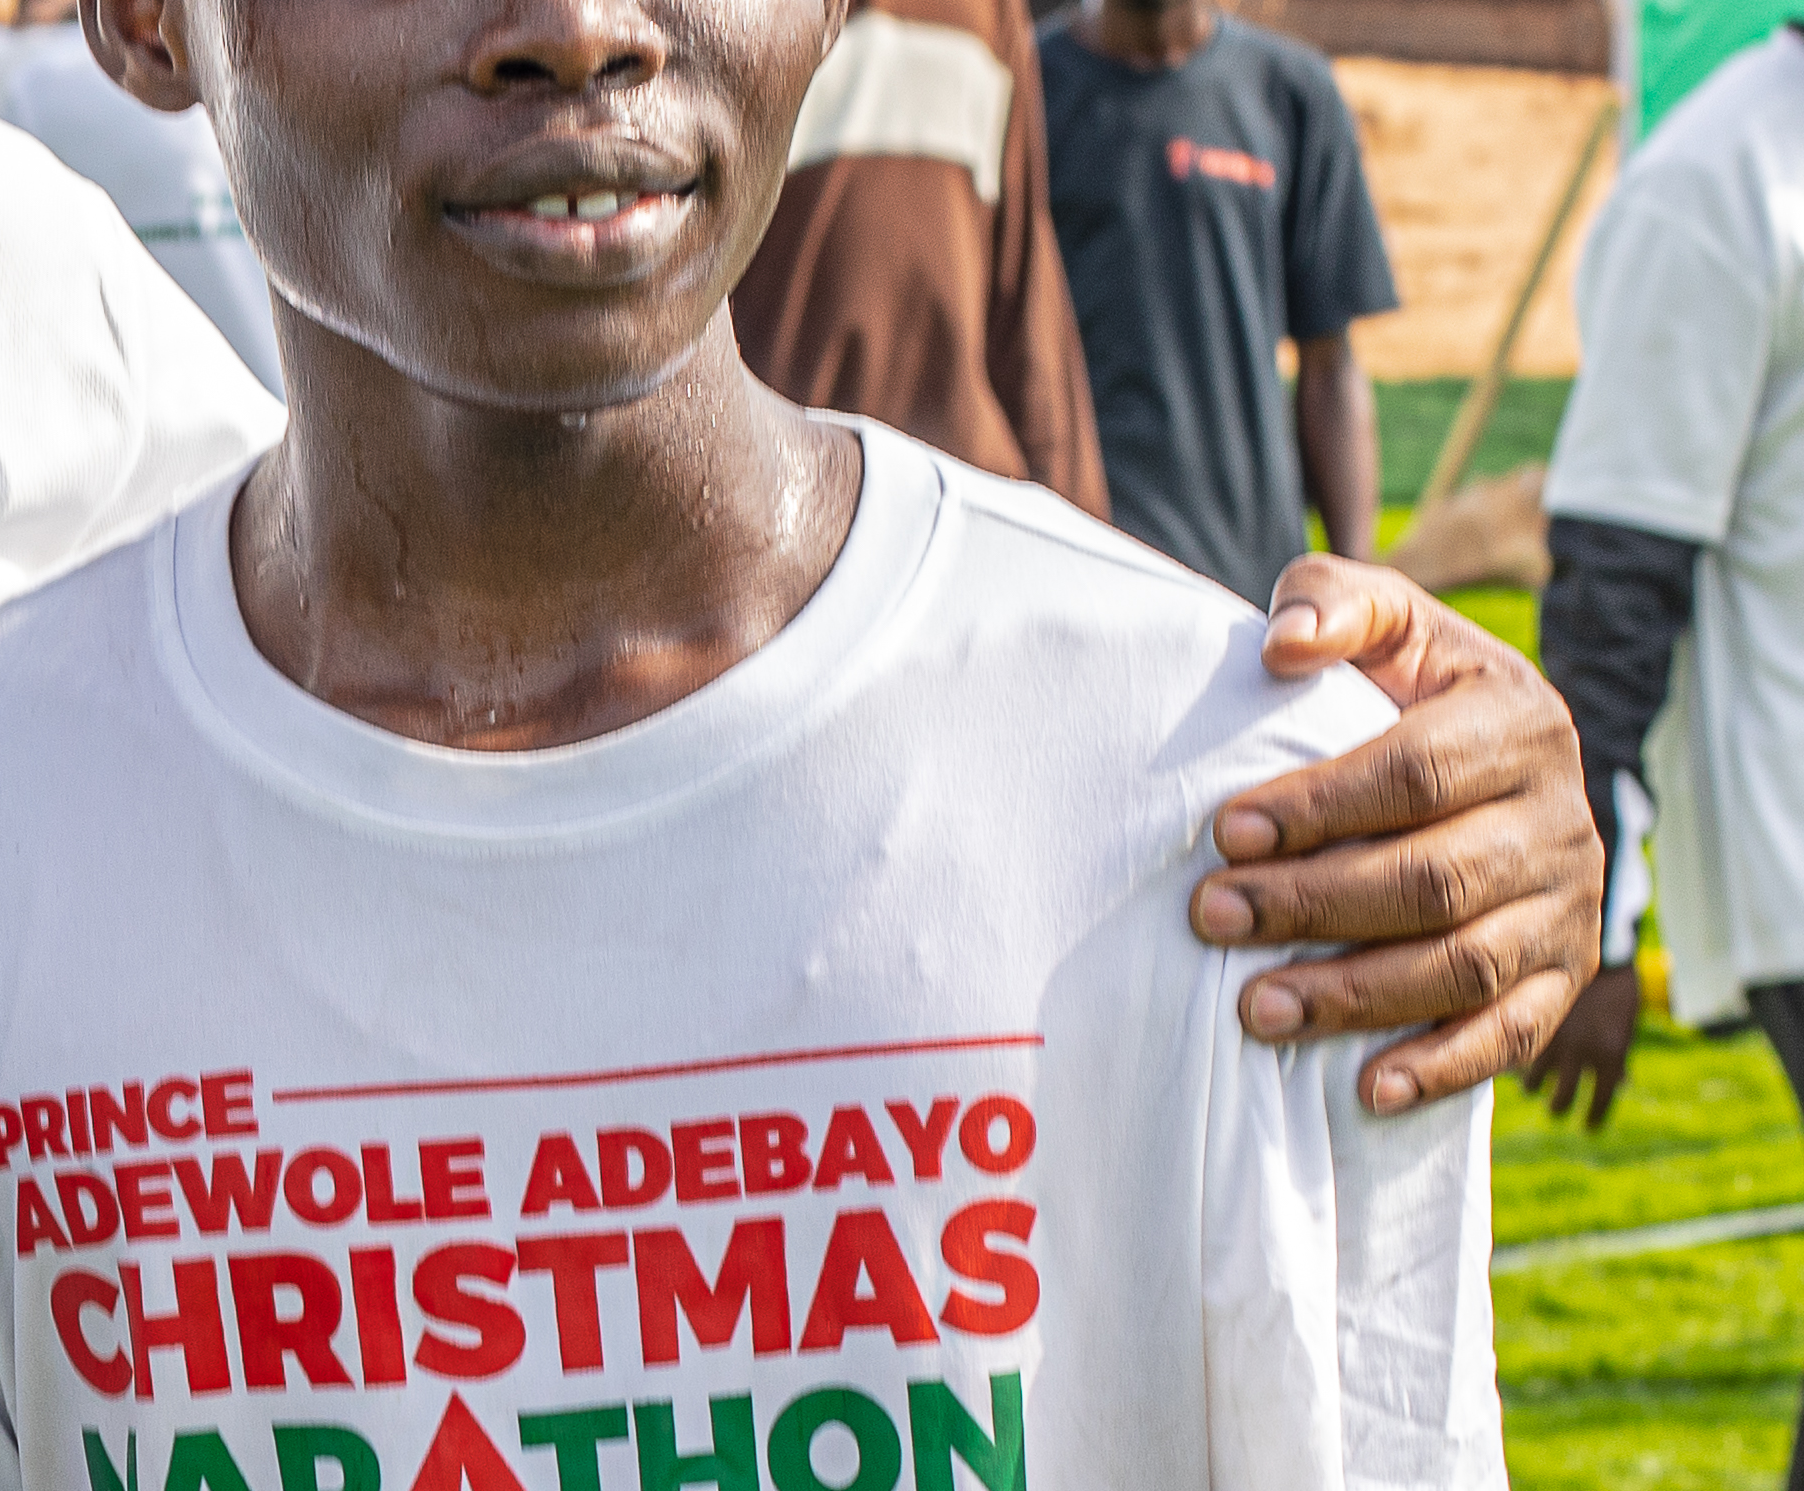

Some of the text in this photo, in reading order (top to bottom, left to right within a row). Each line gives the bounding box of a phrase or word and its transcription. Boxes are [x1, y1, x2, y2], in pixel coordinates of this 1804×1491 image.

[16, 1092, 1038, 1258] ADEWOLE ADEBAYO
[50, 1196, 1041, 1402] CHRISTMAS
